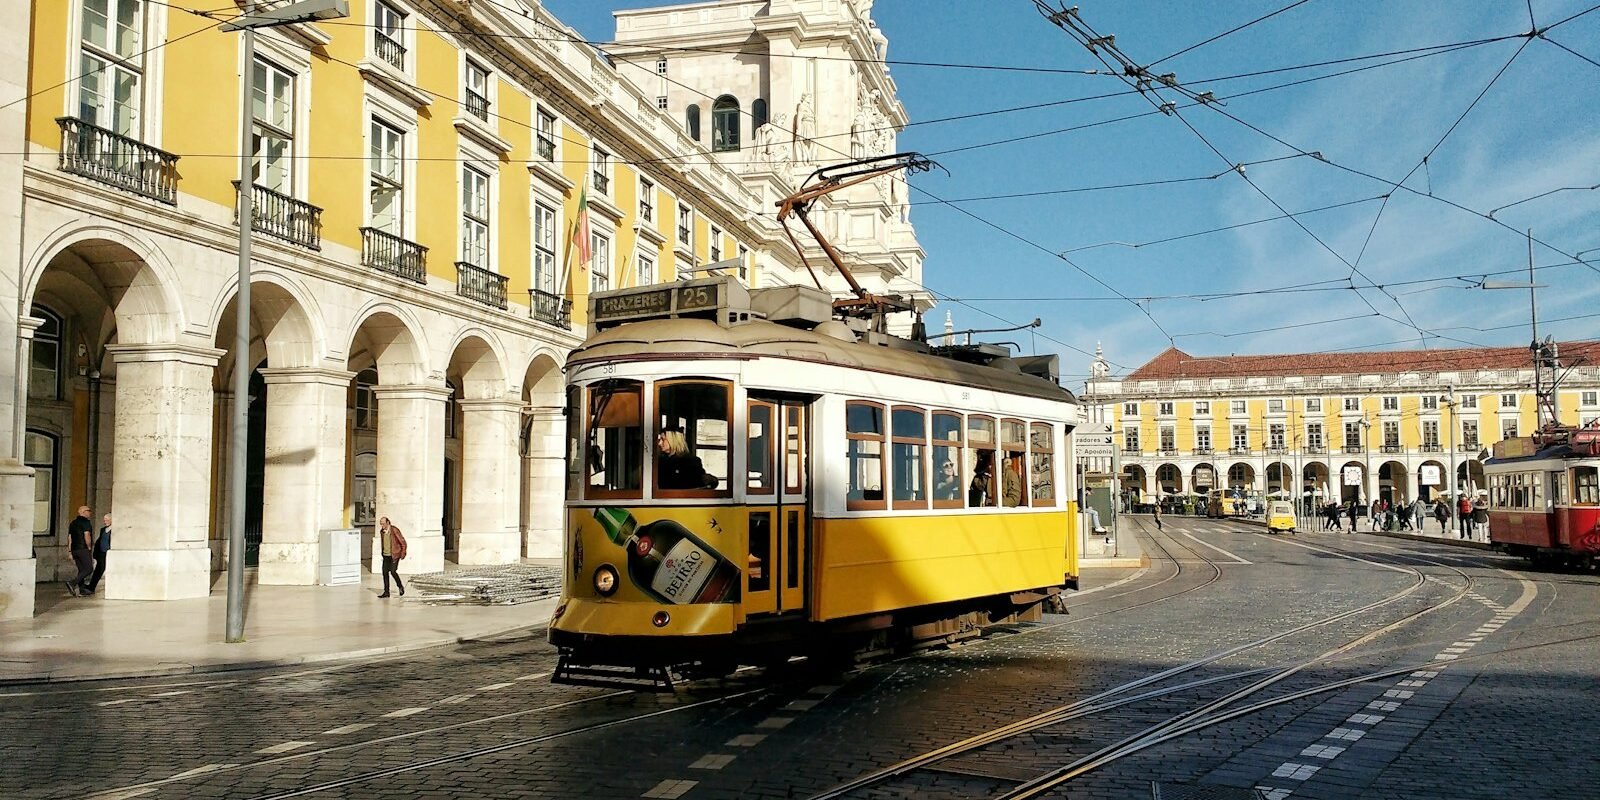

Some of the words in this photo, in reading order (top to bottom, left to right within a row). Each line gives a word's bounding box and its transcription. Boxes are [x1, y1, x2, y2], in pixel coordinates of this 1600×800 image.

[602, 291, 666, 312] PRAZERES
[684, 286, 709, 307] 25
[603, 364, 617, 374] 581
[665, 551, 701, 597] BEIRÃO
